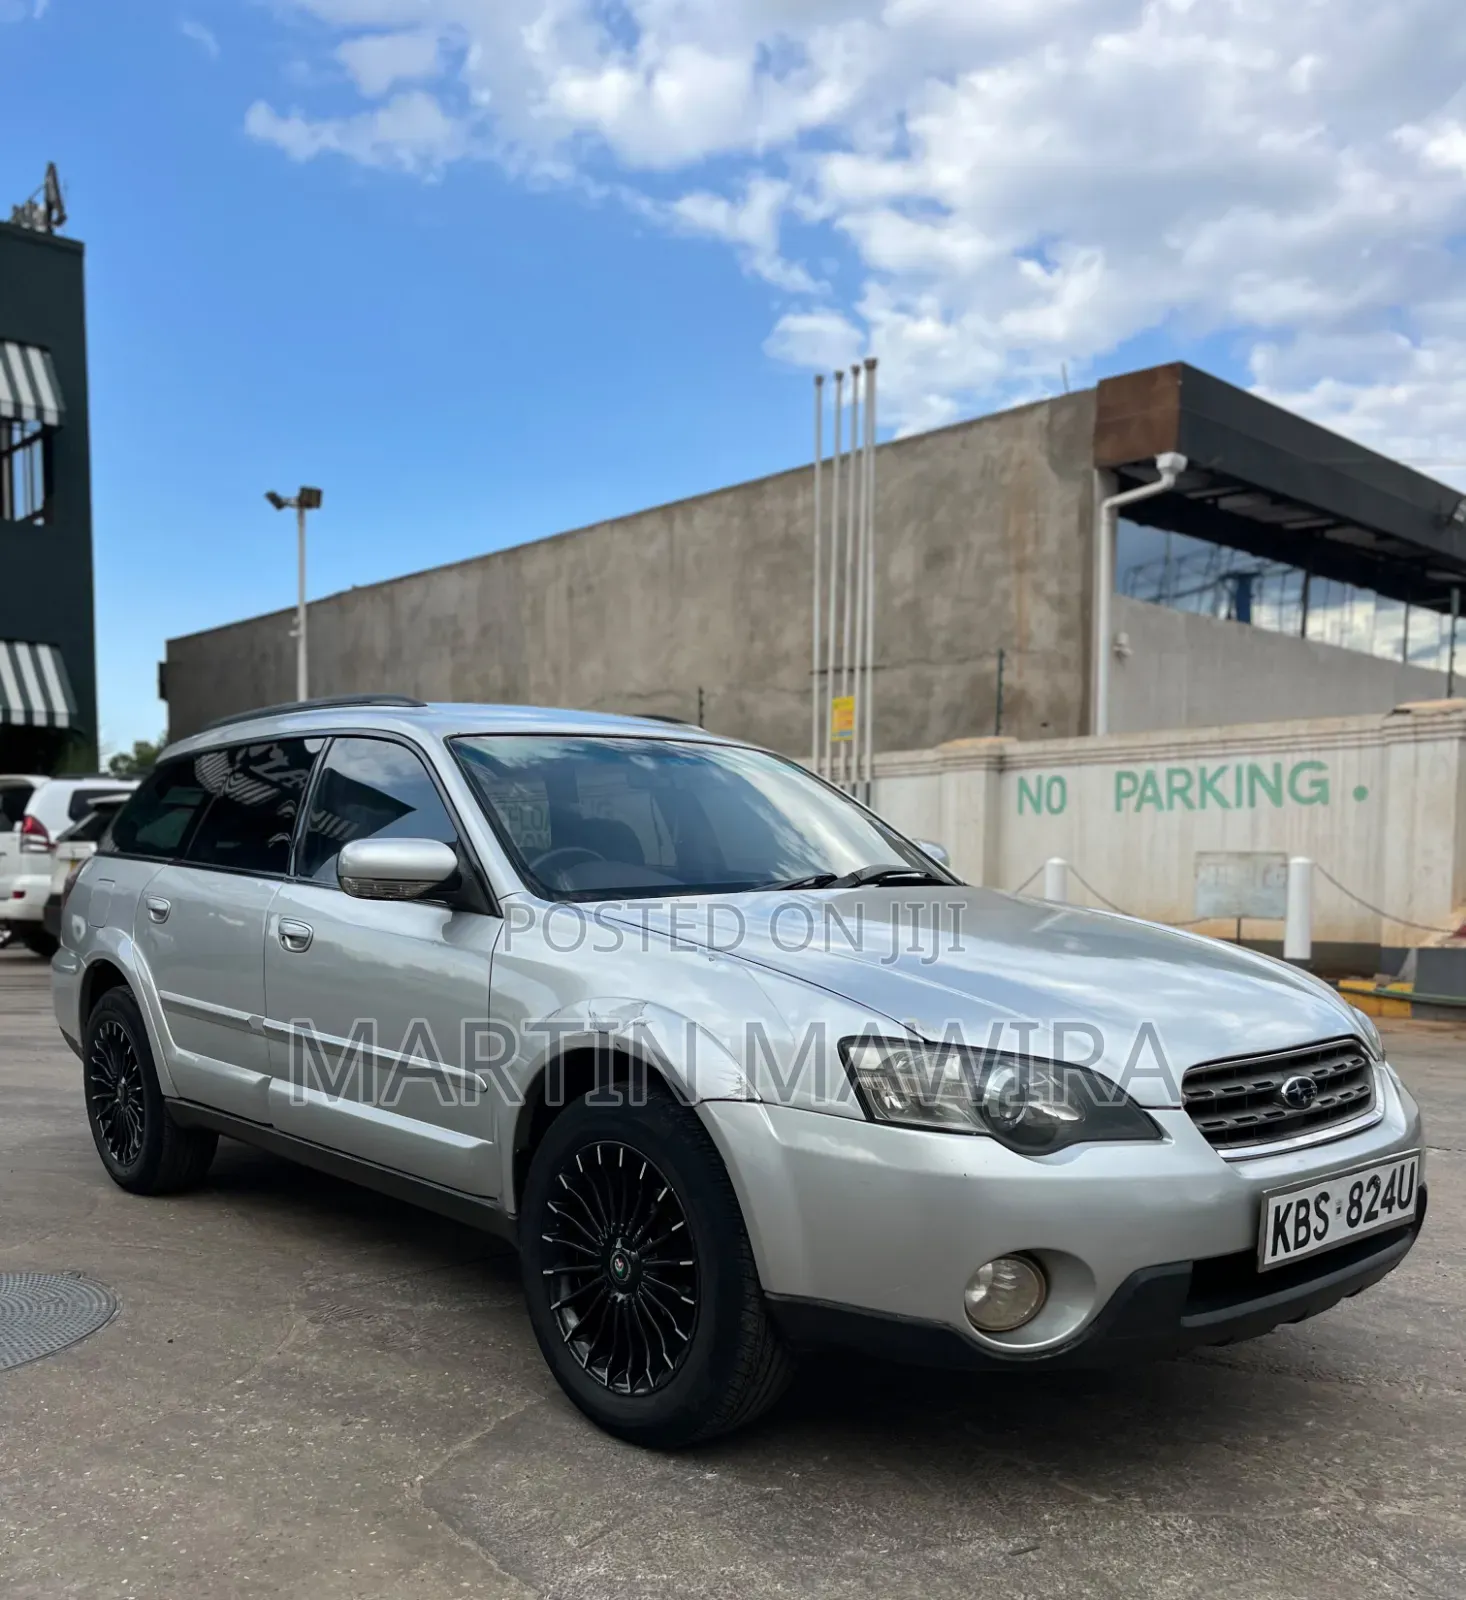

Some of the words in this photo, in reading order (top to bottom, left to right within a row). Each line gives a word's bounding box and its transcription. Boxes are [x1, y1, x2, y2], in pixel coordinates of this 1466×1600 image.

[1017, 775, 1068, 816] NO
[1114, 760, 1330, 813] PARKING
[1271, 1191, 1330, 1257] KBS
[1346, 1161, 1416, 1229] 824U
